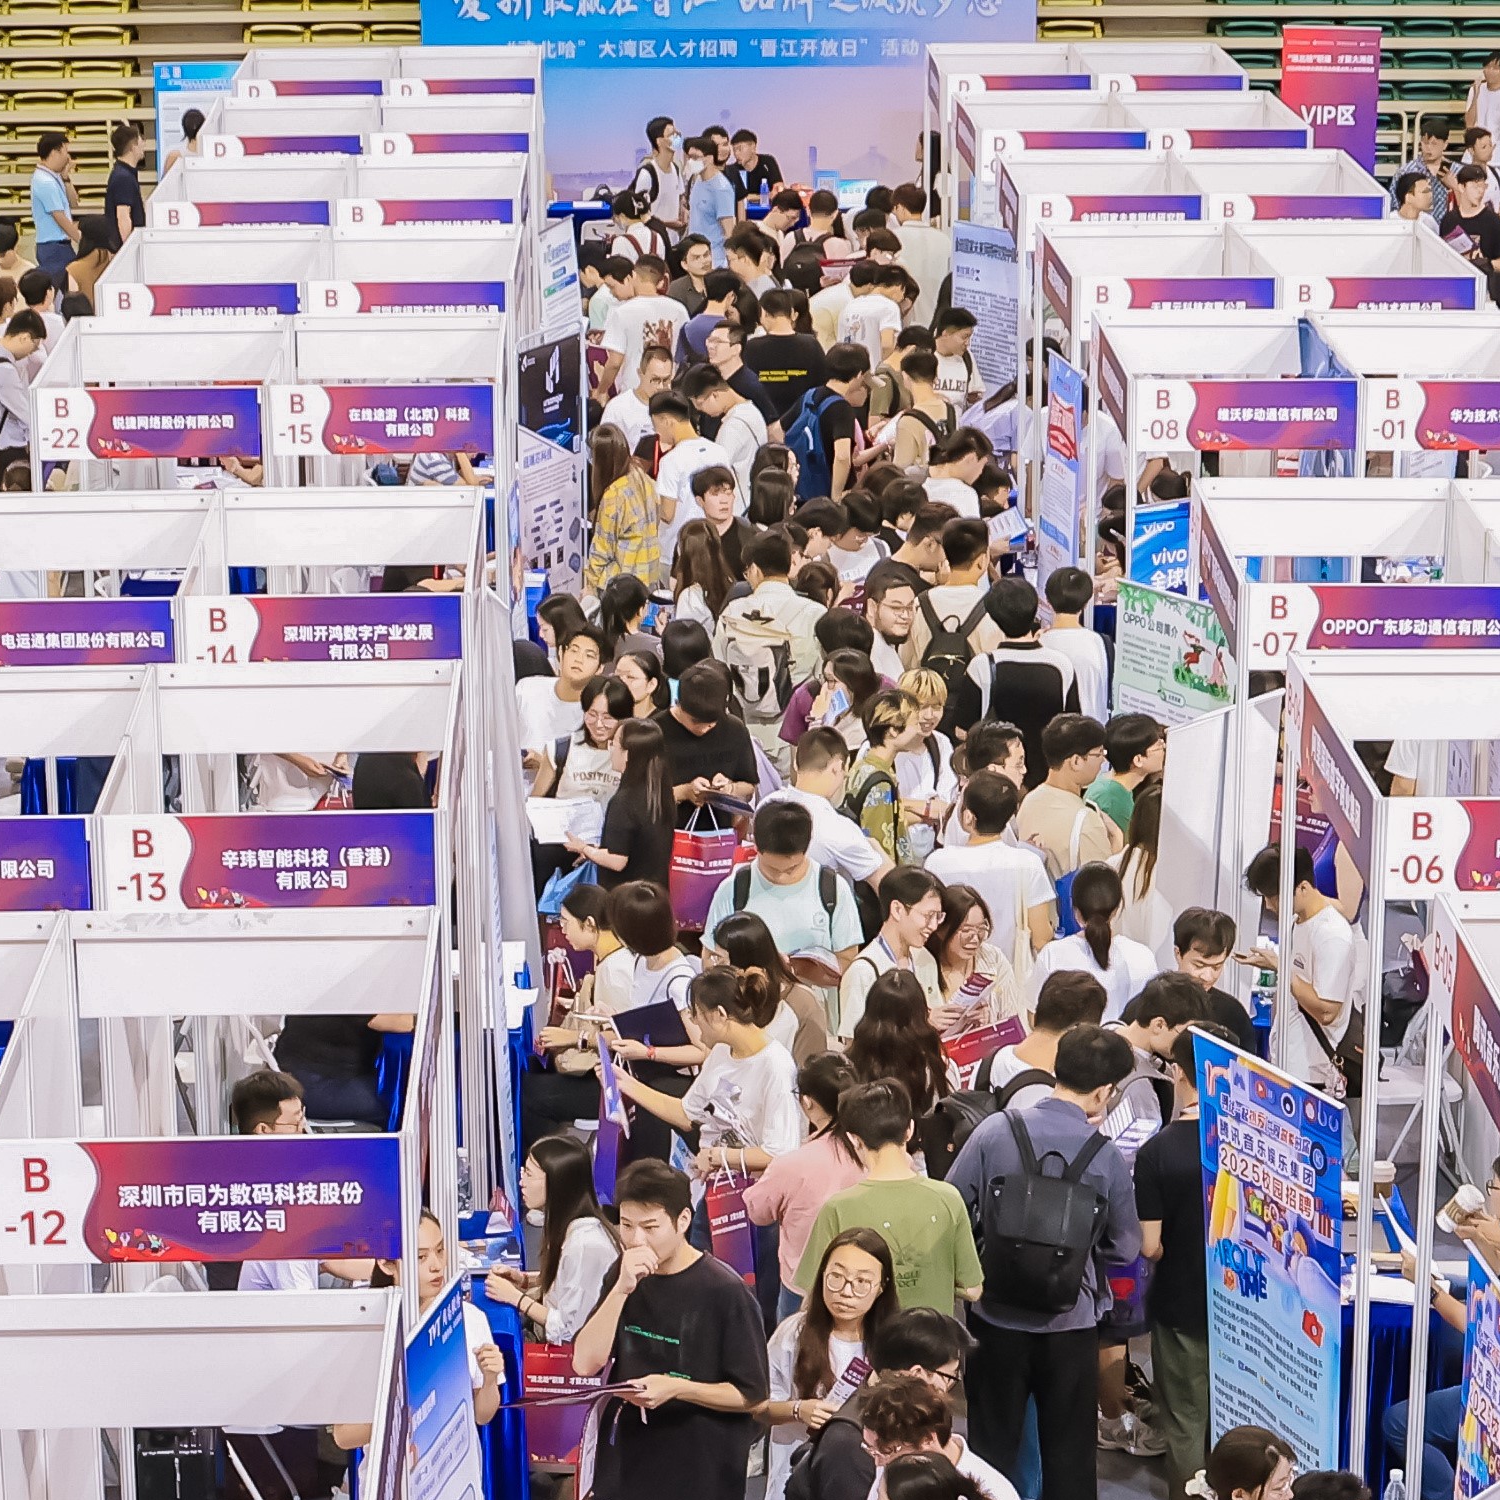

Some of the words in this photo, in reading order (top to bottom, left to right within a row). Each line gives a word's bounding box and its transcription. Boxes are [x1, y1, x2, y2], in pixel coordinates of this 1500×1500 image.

[1301, 105, 1355, 126] VIP区
[1042, 201, 1052, 218] B
[1223, 201, 1234, 218] B
[119, 292, 130, 310] B
[326, 289, 337, 307] B
[1097, 286, 1108, 303] B
[1299, 285, 1311, 303] B
[54, 398, 69, 418] B
[290, 394, 304, 413] B
[1157, 390, 1169, 409] B
[1386, 390, 1399, 409] B
[112, 413, 234, 431] 锐捷网络股份有限公司
[349, 407, 469, 423] 在线途游（北京）科技
[1217, 406, 1338, 424] 维沃移动通信有限公司
[42, 427, 80, 449] -22
[279, 423, 313, 445] -15
[385, 423, 434, 437] 有限公司
[1142, 419, 1179, 440] -08
[1373, 419, 1406, 440] -01
[1143, 521, 1175, 533] vivo
[1152, 547, 1187, 565] vivo
[1151, 569, 1190, 590] 全球
[1271, 597, 1287, 619] B
[209, 608, 227, 632] B
[283, 624, 433, 643] 深圳开鸿数字产业发展
[1253, 632, 1298, 656] -07
[328, 643, 389, 660] 有限公司
[1412, 812, 1432, 841] B
[132, 830, 154, 858] B
[222, 846, 391, 868] 辛玮智能科技（香港）
[1390, 855, 1443, 883] -06
[117, 872, 166, 901] -13
[276, 870, 348, 890] 有限公司
[1433, 931, 1455, 992] B-05
[1219, 1119, 1315, 1188] 腾讯音乐娱乐集团
[24, 1158, 50, 1192] B
[1220, 1147, 1315, 1218] 2025校园招聘
[118, 1181, 363, 1208] 深圳市同为数码科技股份
[5, 1211, 67, 1246] -12
[198, 1208, 286, 1234] 有限公司
